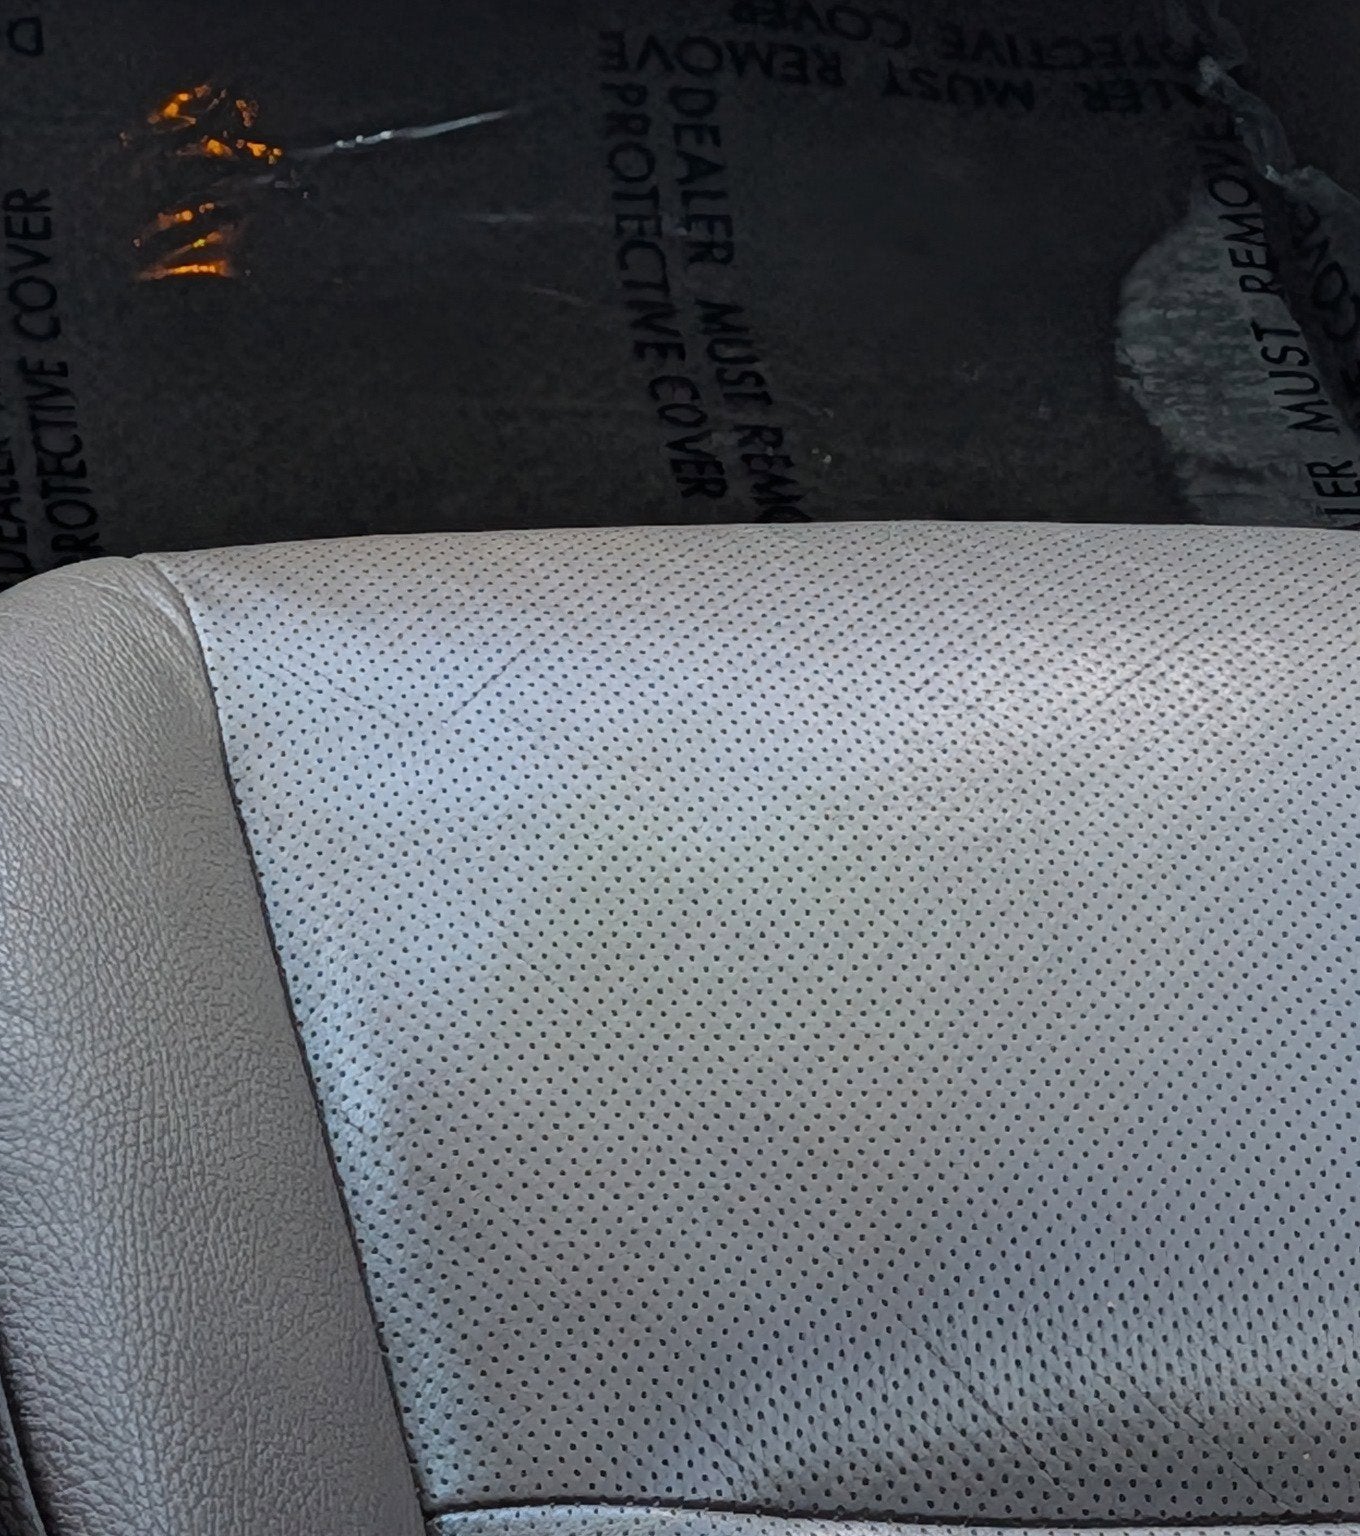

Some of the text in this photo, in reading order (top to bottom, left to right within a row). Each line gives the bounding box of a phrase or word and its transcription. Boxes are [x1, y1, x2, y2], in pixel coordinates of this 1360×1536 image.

[597, 29, 846, 89] REMOVE
[882, 59, 1035, 114] MUST
[668, 85, 735, 268] DEALER
[1, 187, 62, 342] COVER
[598, 82, 729, 502] PROTECTIVE COVER
[695, 296, 773, 410] MUST
[1250, 319, 1342, 436] MUST
